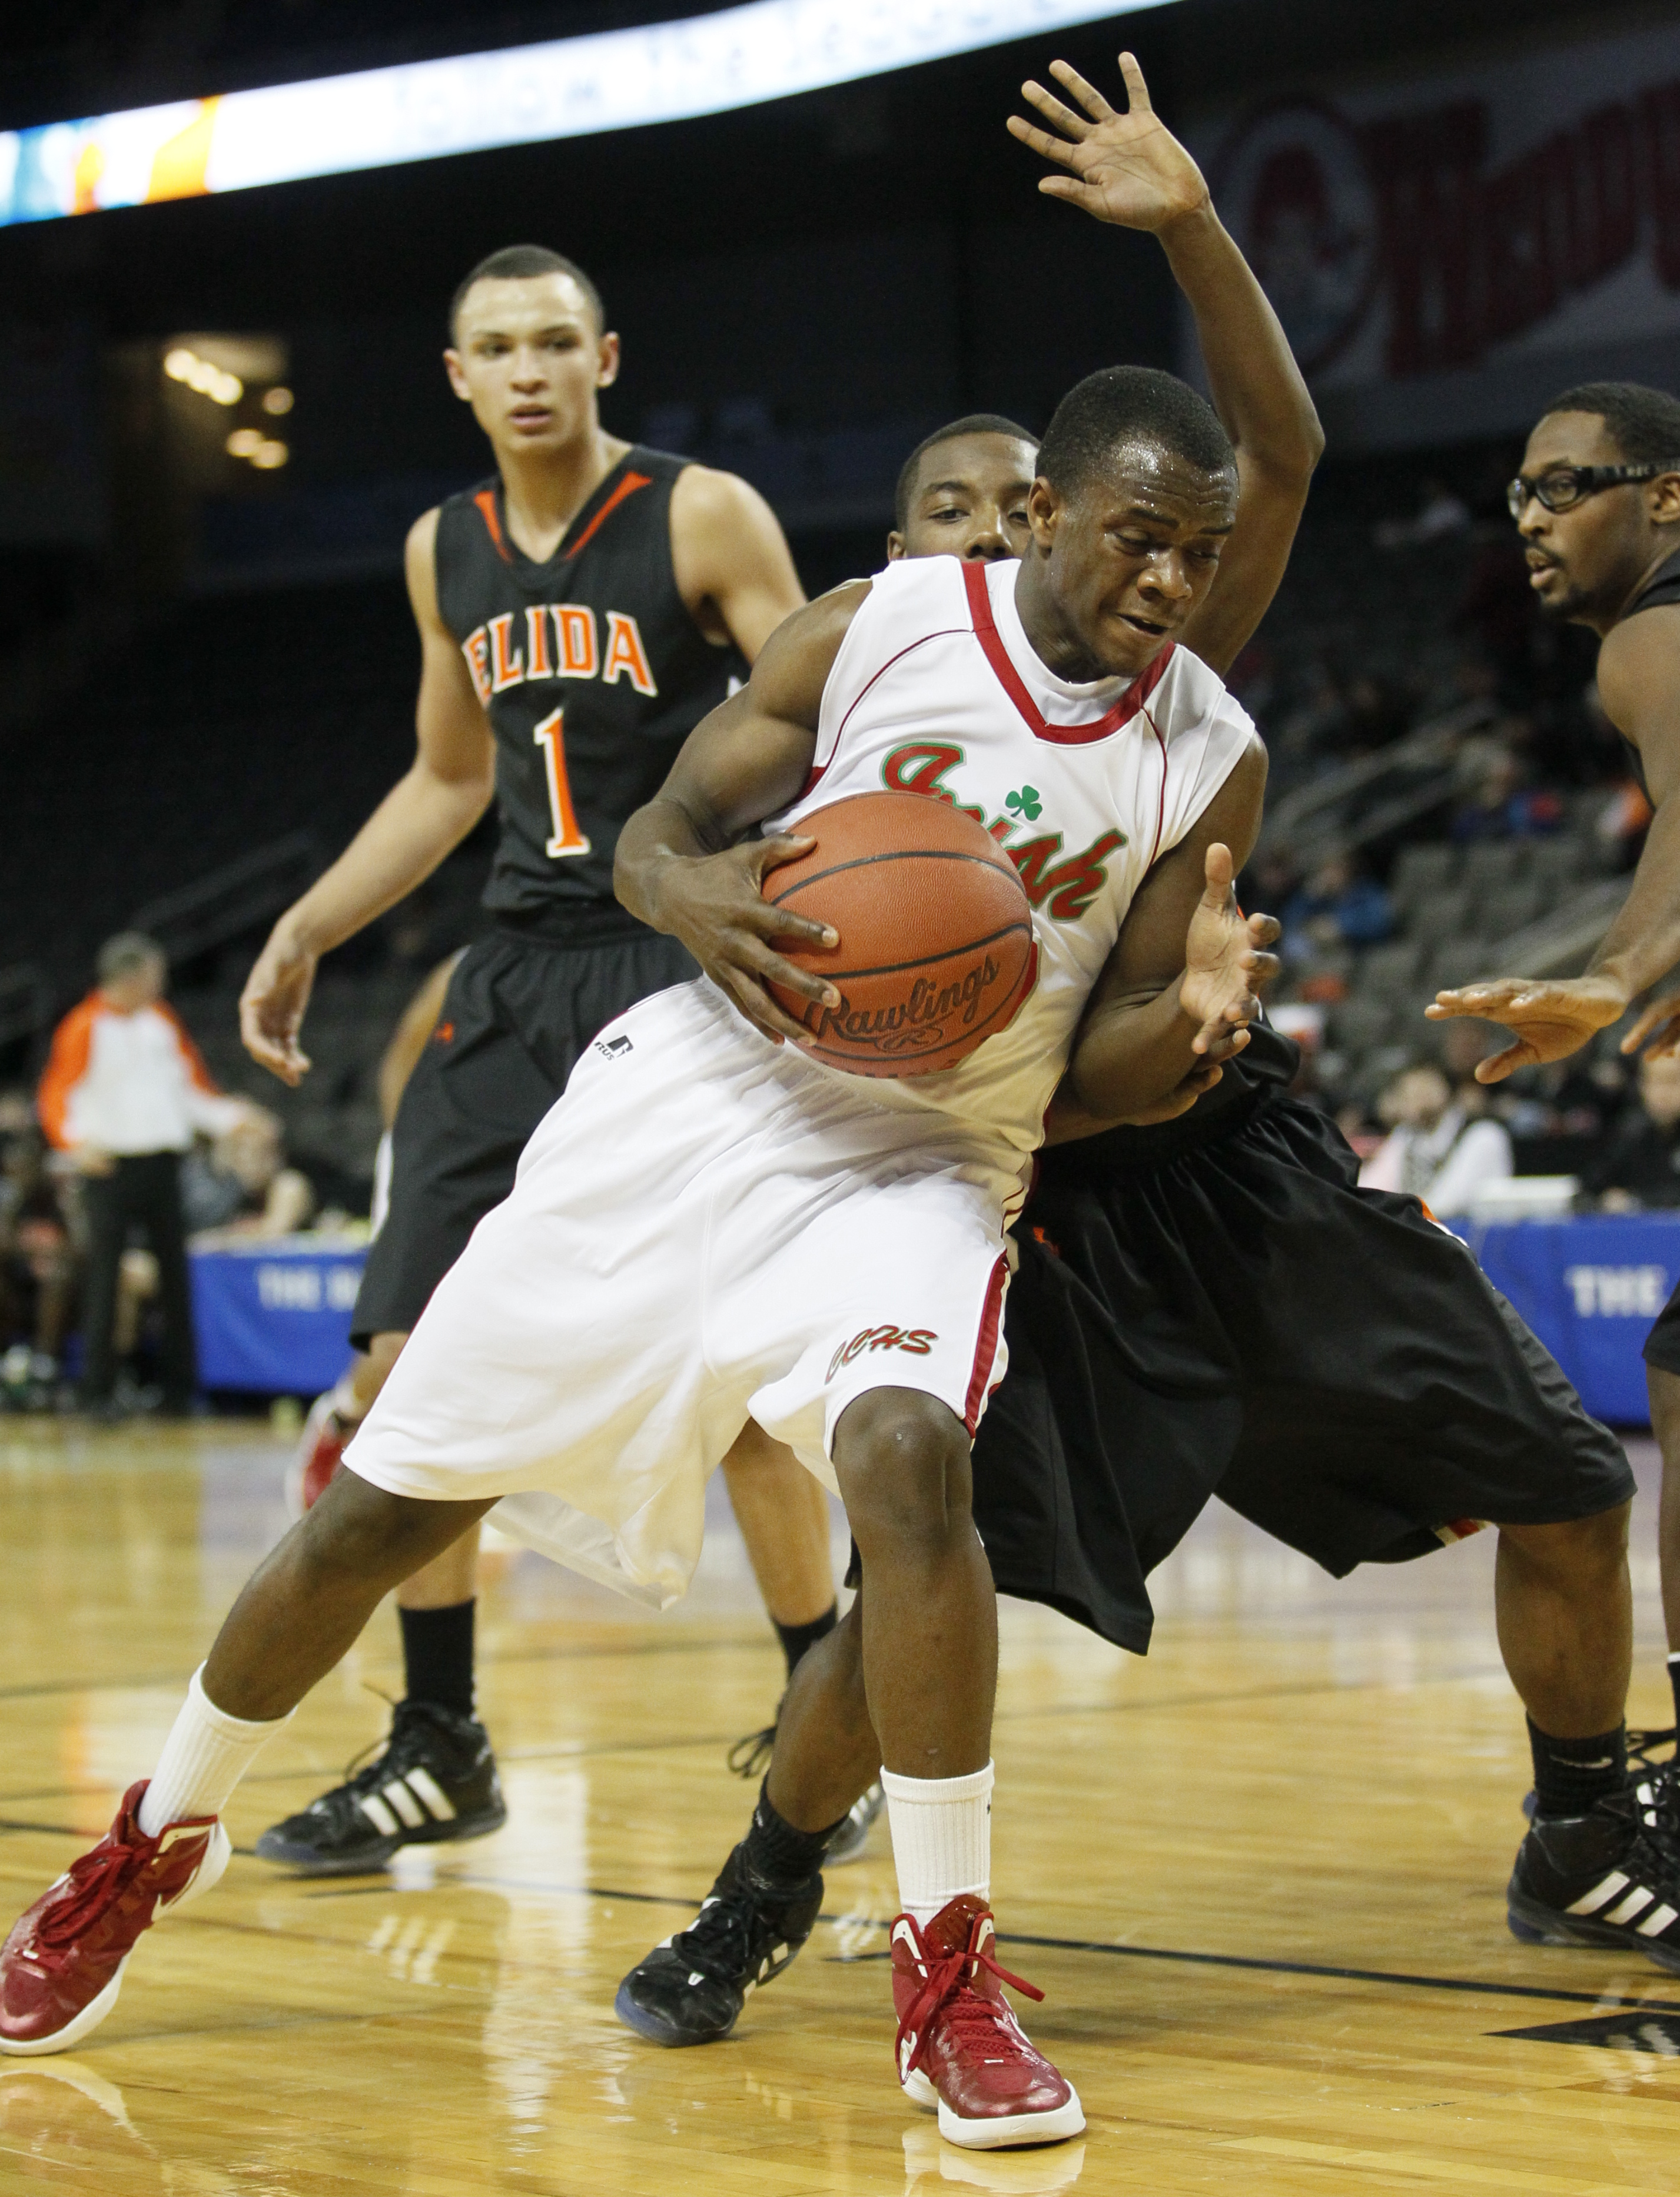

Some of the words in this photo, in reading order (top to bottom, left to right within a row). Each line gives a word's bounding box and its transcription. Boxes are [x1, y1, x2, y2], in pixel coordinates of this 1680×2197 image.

[461, 603, 658, 708] ELIDA
[533, 708, 590, 858] 1
[881, 739, 1130, 923] Ish
[803, 954, 1001, 1043] Rawlings
[1562, 1265, 1668, 1319] THE
